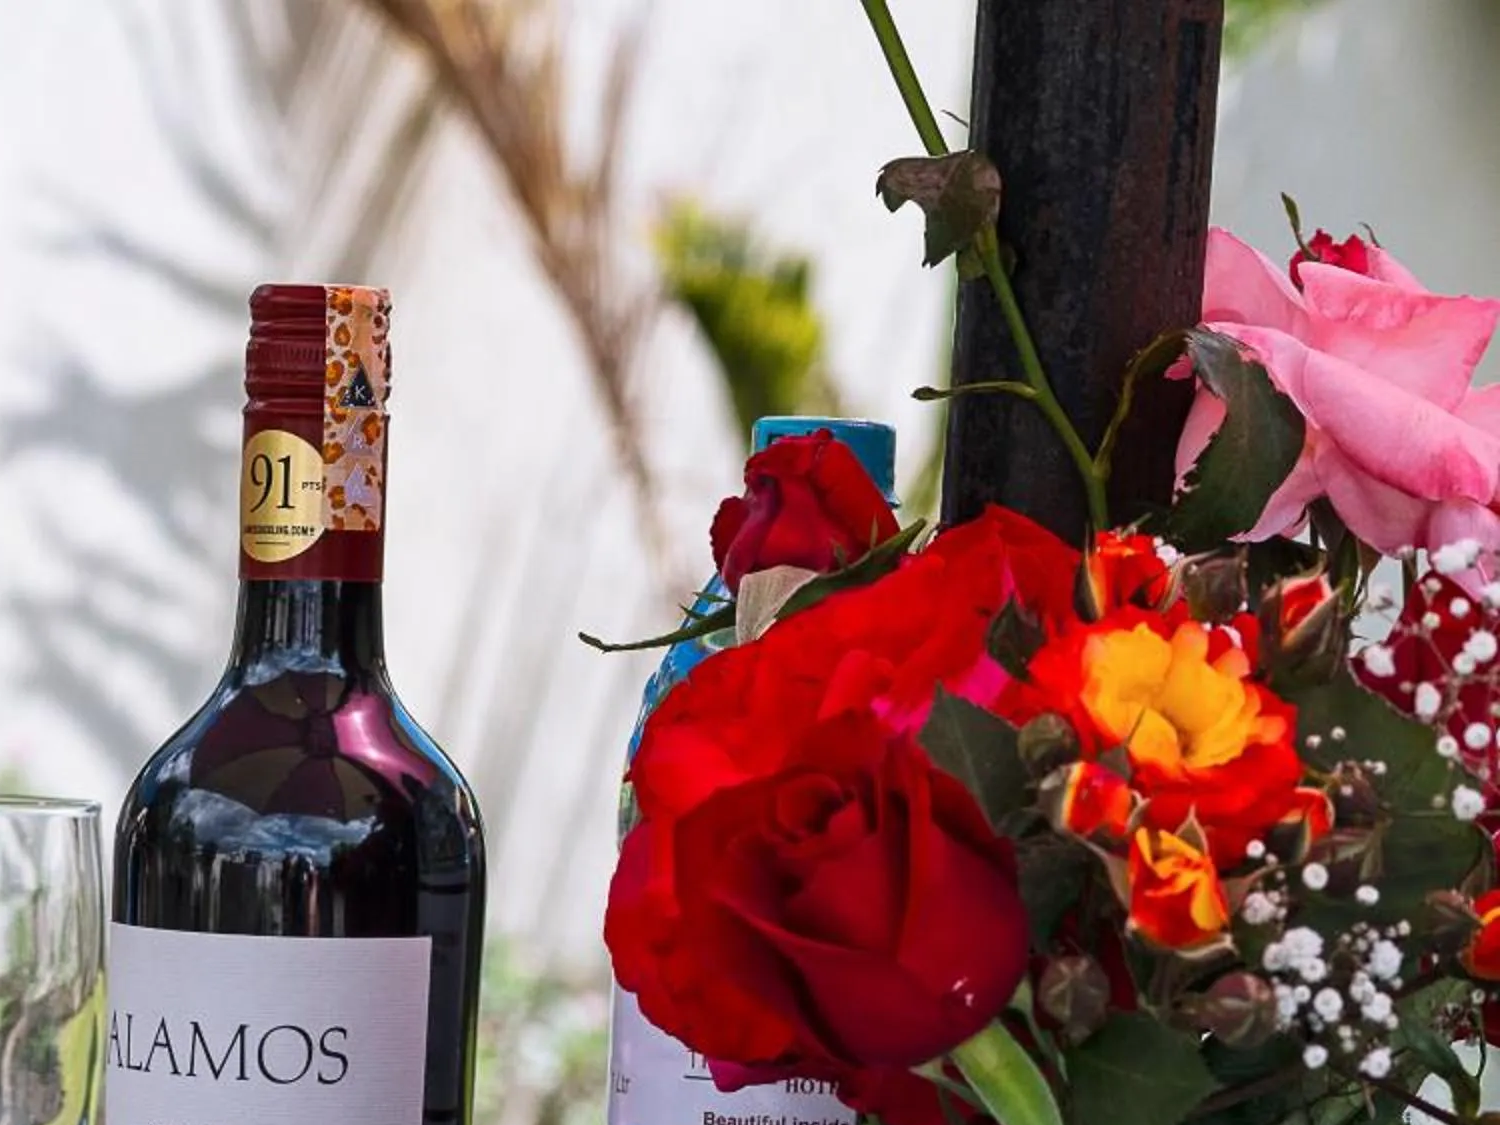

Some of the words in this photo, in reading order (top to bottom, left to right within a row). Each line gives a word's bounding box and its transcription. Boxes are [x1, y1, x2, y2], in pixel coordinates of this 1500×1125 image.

[250, 453, 296, 514] 91
[301, 480, 321, 491] PTS
[106, 1008, 350, 1085] ALAMOS
